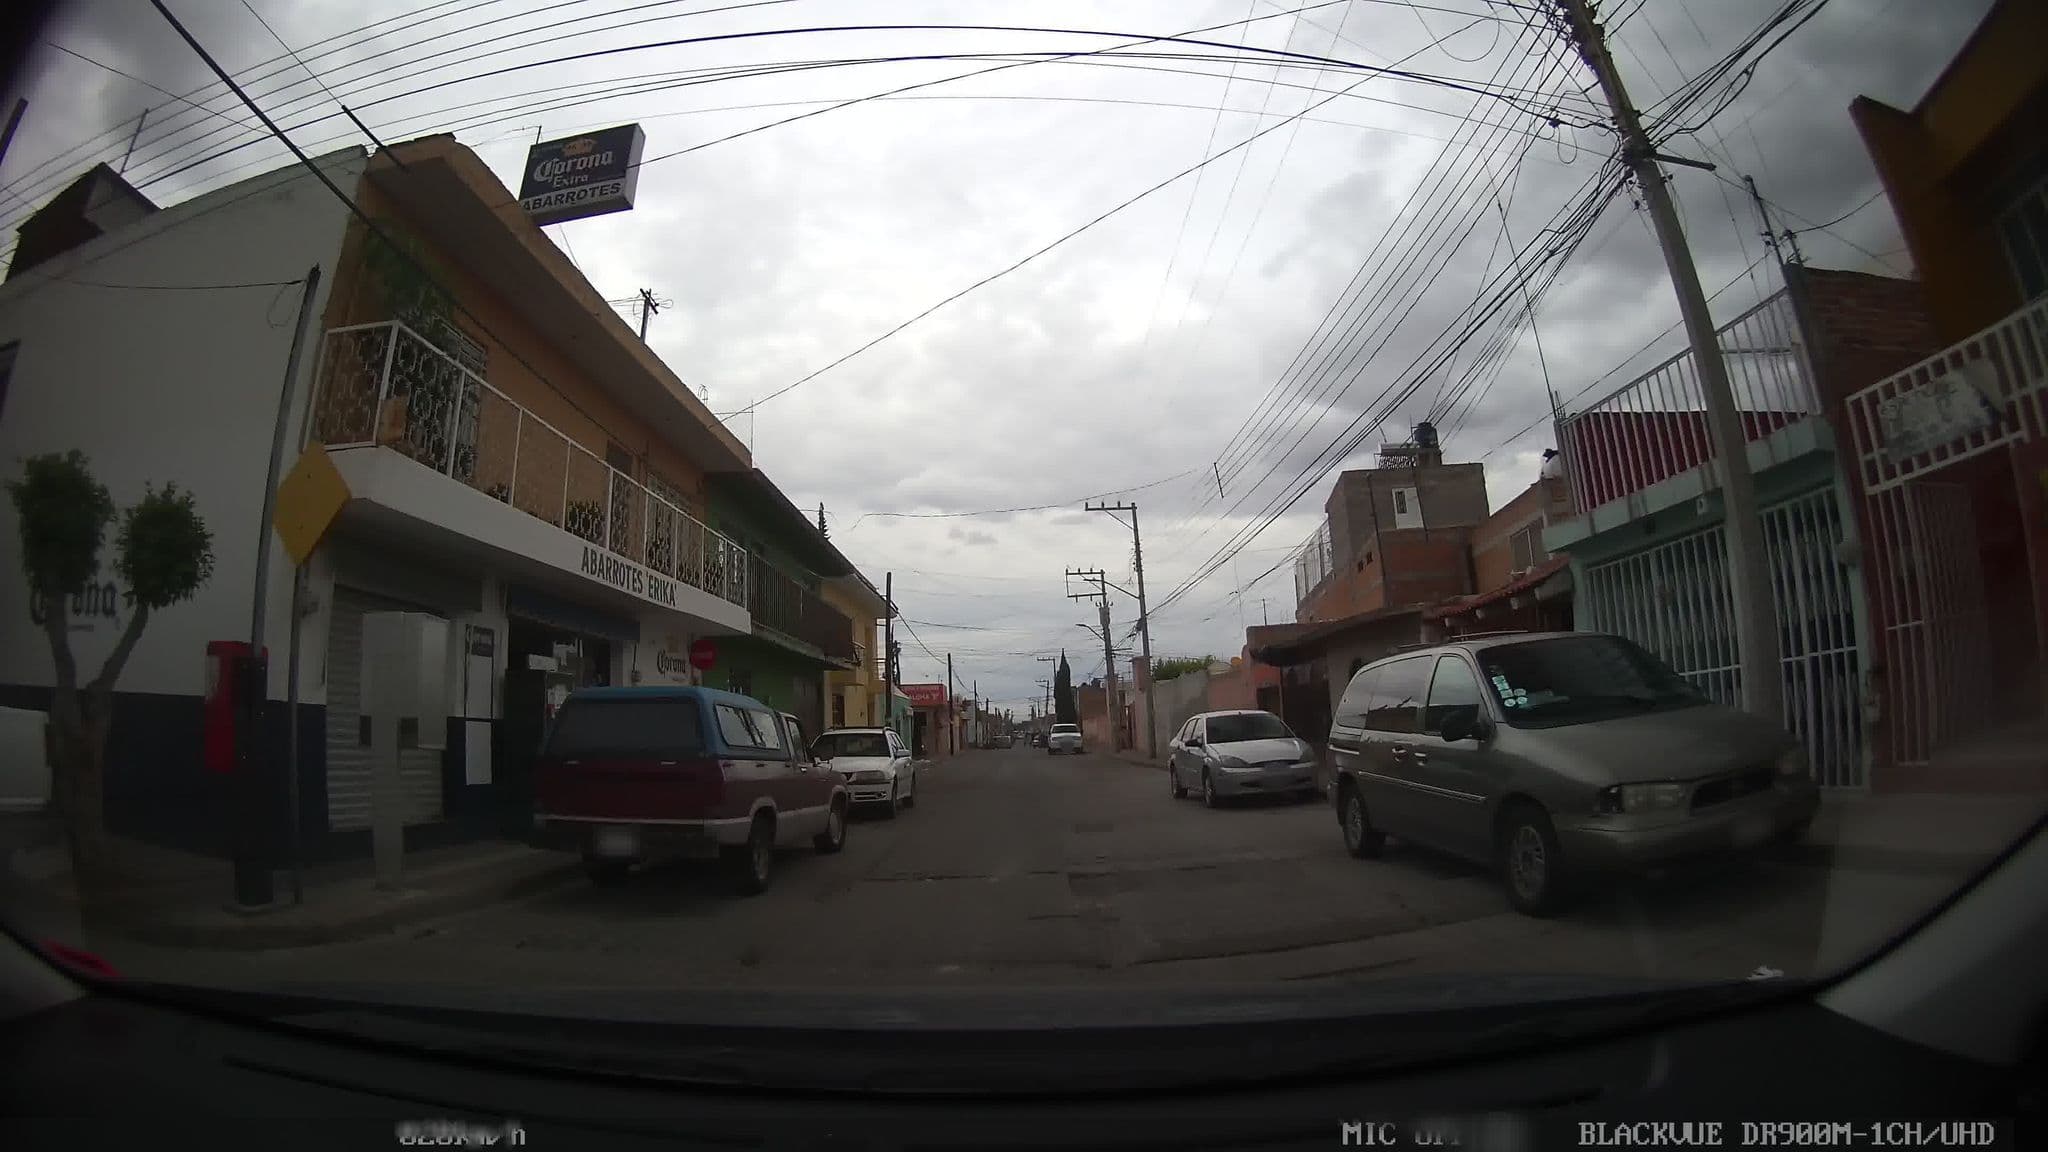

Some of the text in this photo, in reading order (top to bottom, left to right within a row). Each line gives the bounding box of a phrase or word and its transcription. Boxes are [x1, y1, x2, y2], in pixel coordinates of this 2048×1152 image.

[534, 151, 613, 182] Corona
[552, 173, 589, 188] Extra
[523, 182, 622, 209] ABARROTES
[581, 546, 643, 594] ABARROTES
[656, 649, 686, 678] Corona
